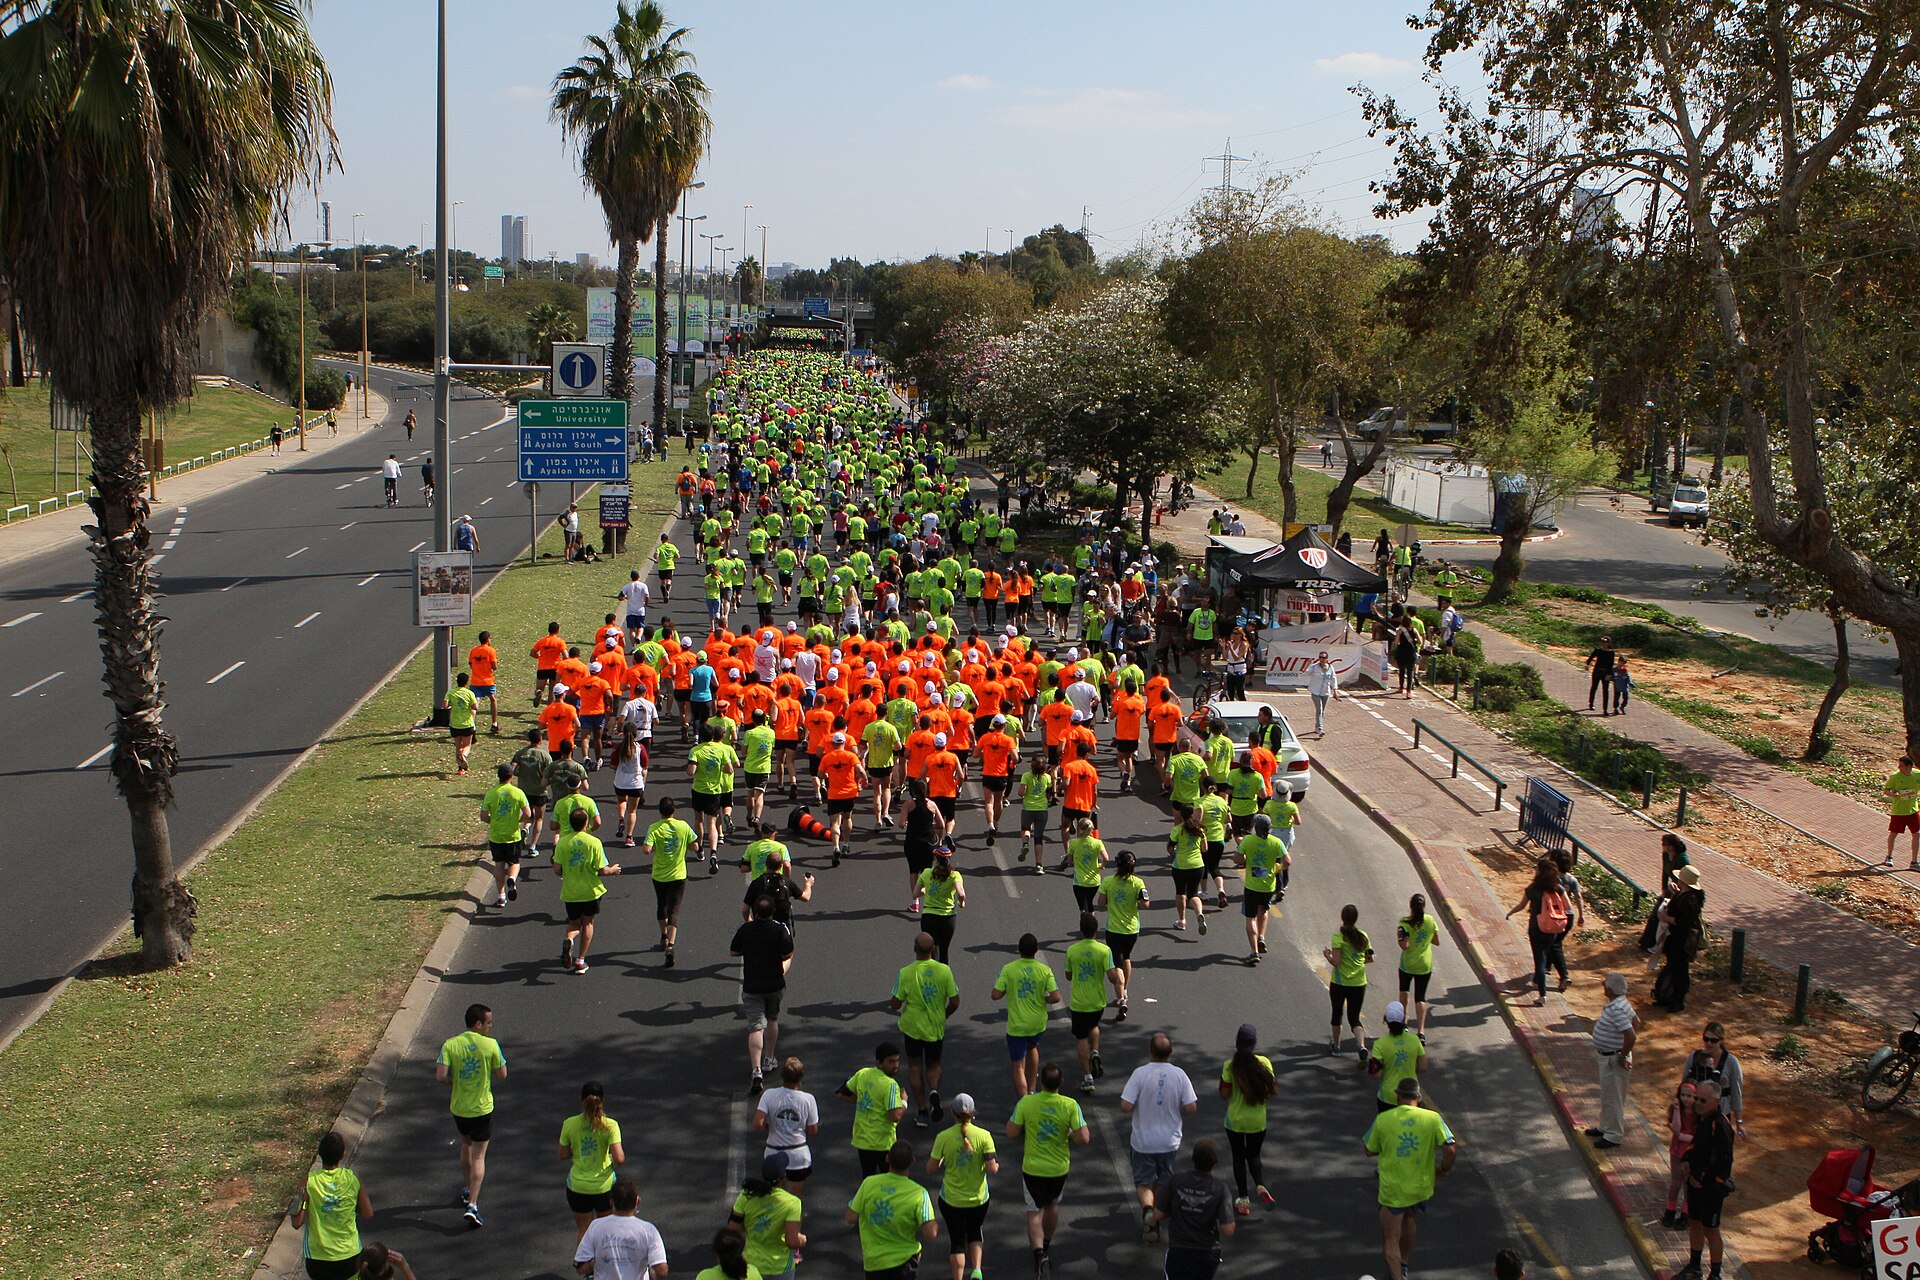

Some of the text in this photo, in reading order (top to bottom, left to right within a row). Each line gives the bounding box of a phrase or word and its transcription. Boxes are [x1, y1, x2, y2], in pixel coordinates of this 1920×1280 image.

[552, 406, 611, 414] אוניברסיטה
[556, 416, 607, 424] University
[541, 432, 596, 441] אילון דרום
[534, 441, 567, 449] Ayalon
[546, 458, 600, 467] אילון צפון
[540, 467, 606, 475] Ayalon North
[1295, 579, 1345, 590] TREK
[1879, 1224, 1920, 1256] G
